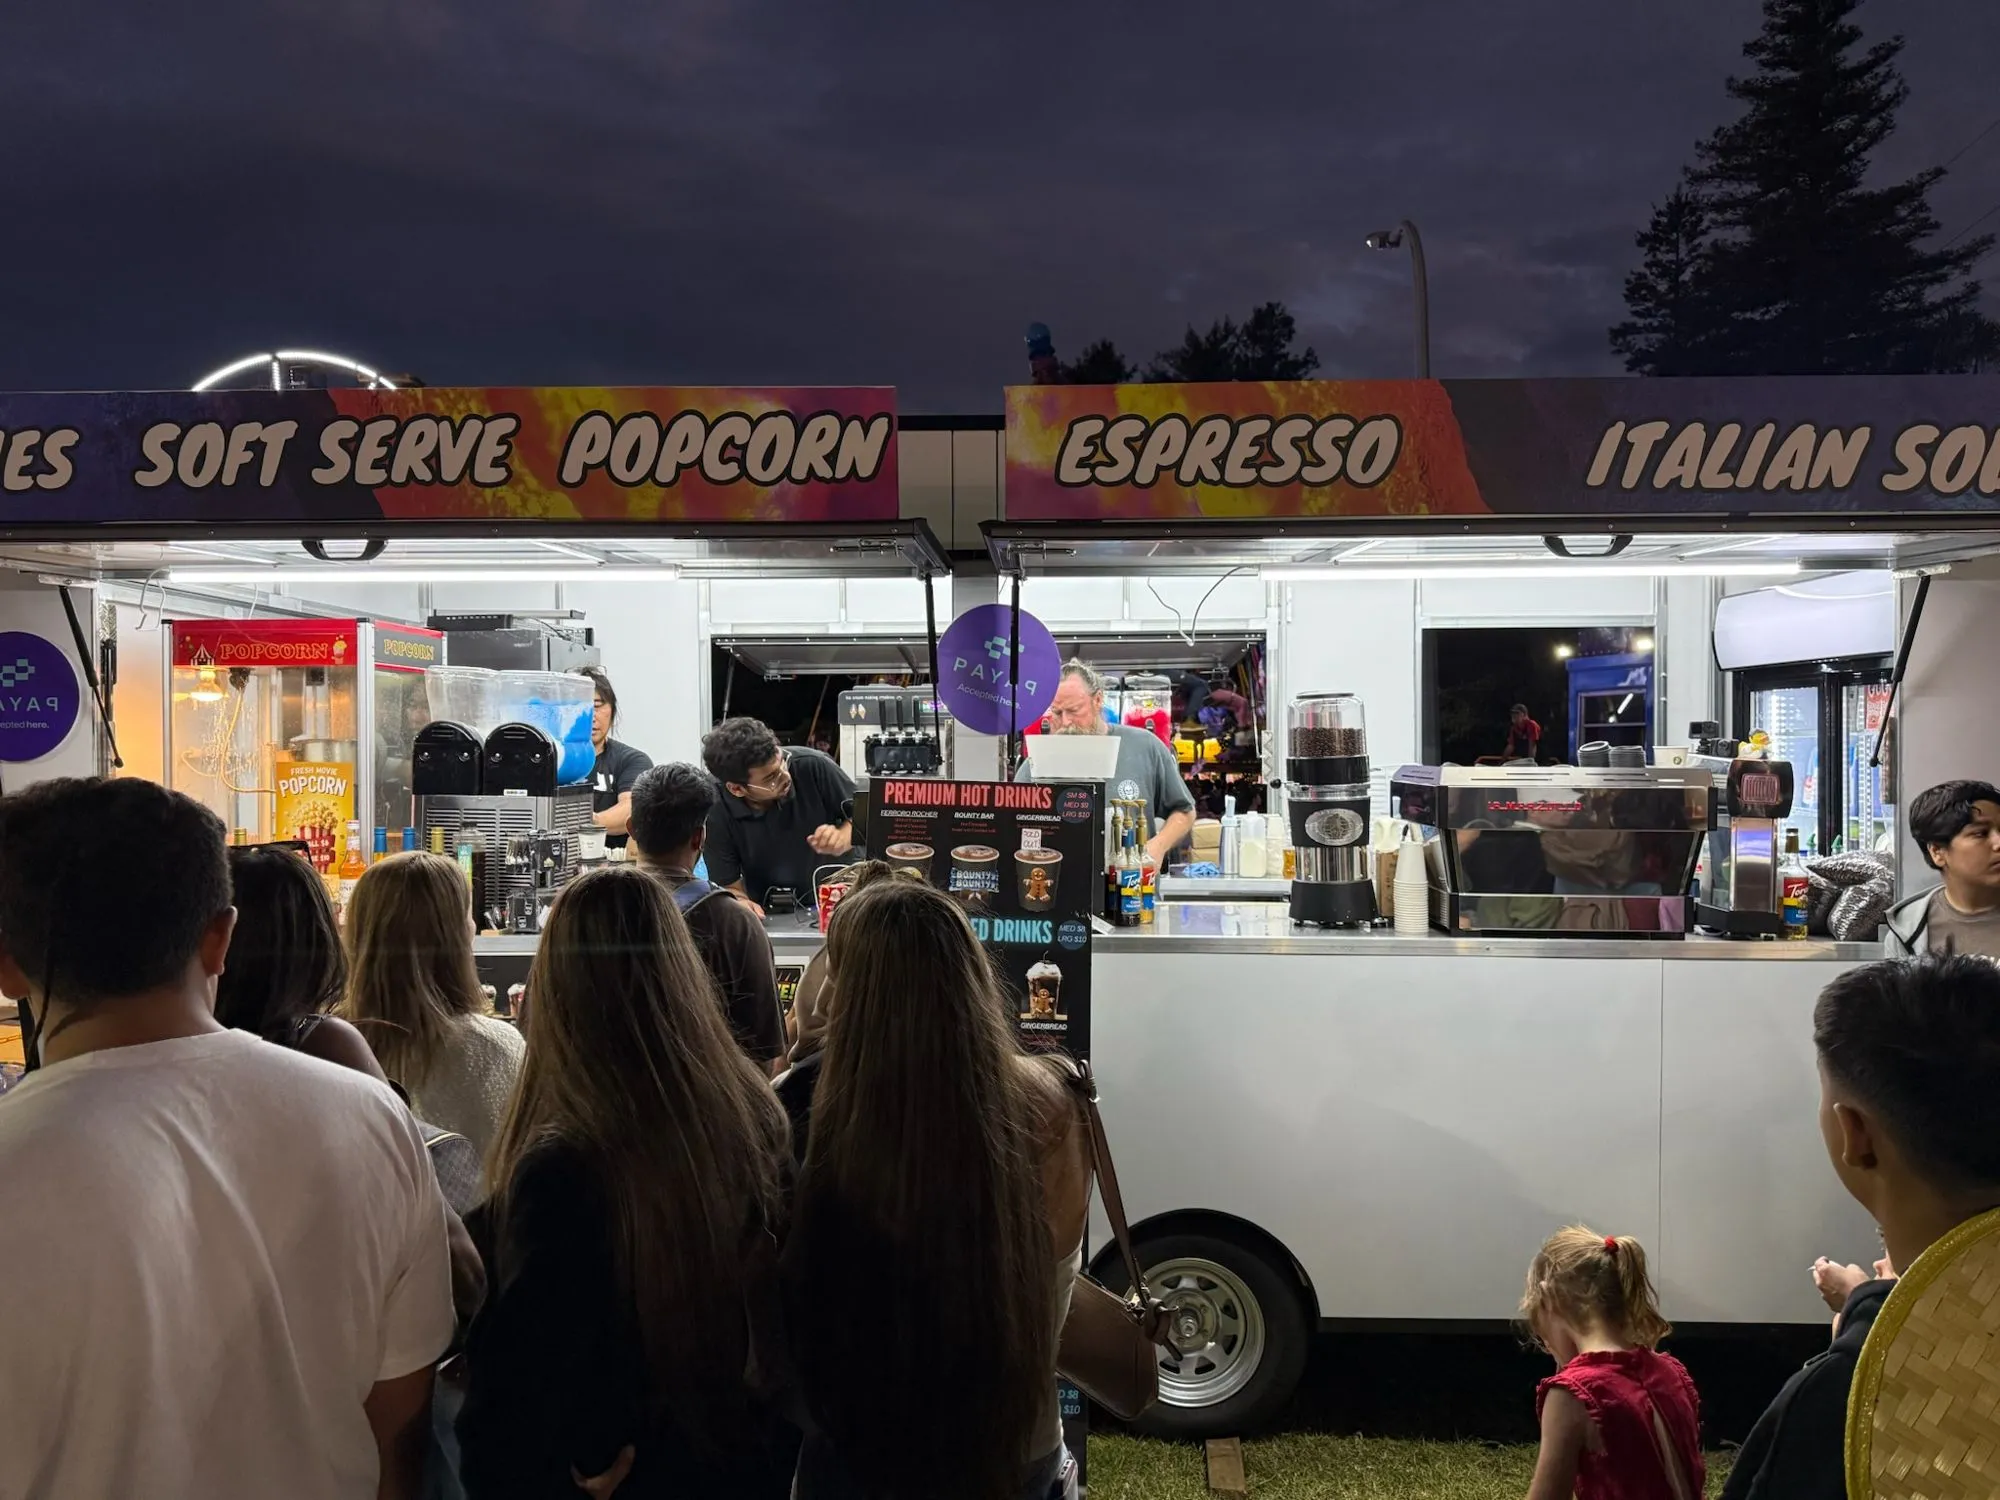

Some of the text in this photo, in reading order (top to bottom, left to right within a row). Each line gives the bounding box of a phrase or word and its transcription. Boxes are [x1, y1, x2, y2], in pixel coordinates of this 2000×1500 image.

[134, 415, 519, 489] SOFT SERVE
[562, 411, 890, 486] POPCORN
[1058, 415, 1398, 486] ESPRESSO
[0, 427, 81, 492] ES
[1586, 421, 1872, 489] ITALIAN
[220, 642, 329, 660] POPCORN
[383, 638, 435, 661] POPCORN
[956, 683, 1000, 702] Accepted
[26, 721, 50, 729] here.
[290, 766, 339, 776] FRESH MOVIE
[278, 775, 348, 798] POPCORN
[884, 781, 1052, 809] PREMIUM HOT DRINKS
[954, 811, 995, 820] BOUNTY BAR
[1016, 813, 1062, 822] GINGERBREAD
[1062, 810, 1077, 818] LRG
[956, 870, 991, 880] BOUNTY
[956, 879, 991, 889] BOUNTY
[970, 918, 1053, 944] ED DRINKS
[1058, 924, 1075, 933] MED
[1057, 935, 1087, 944] LRG $10
[1020, 1022, 1068, 1031] GINGERBREAD
[1066, 1389, 1079, 1400] $8
[1063, 1404, 1081, 1415] $10
